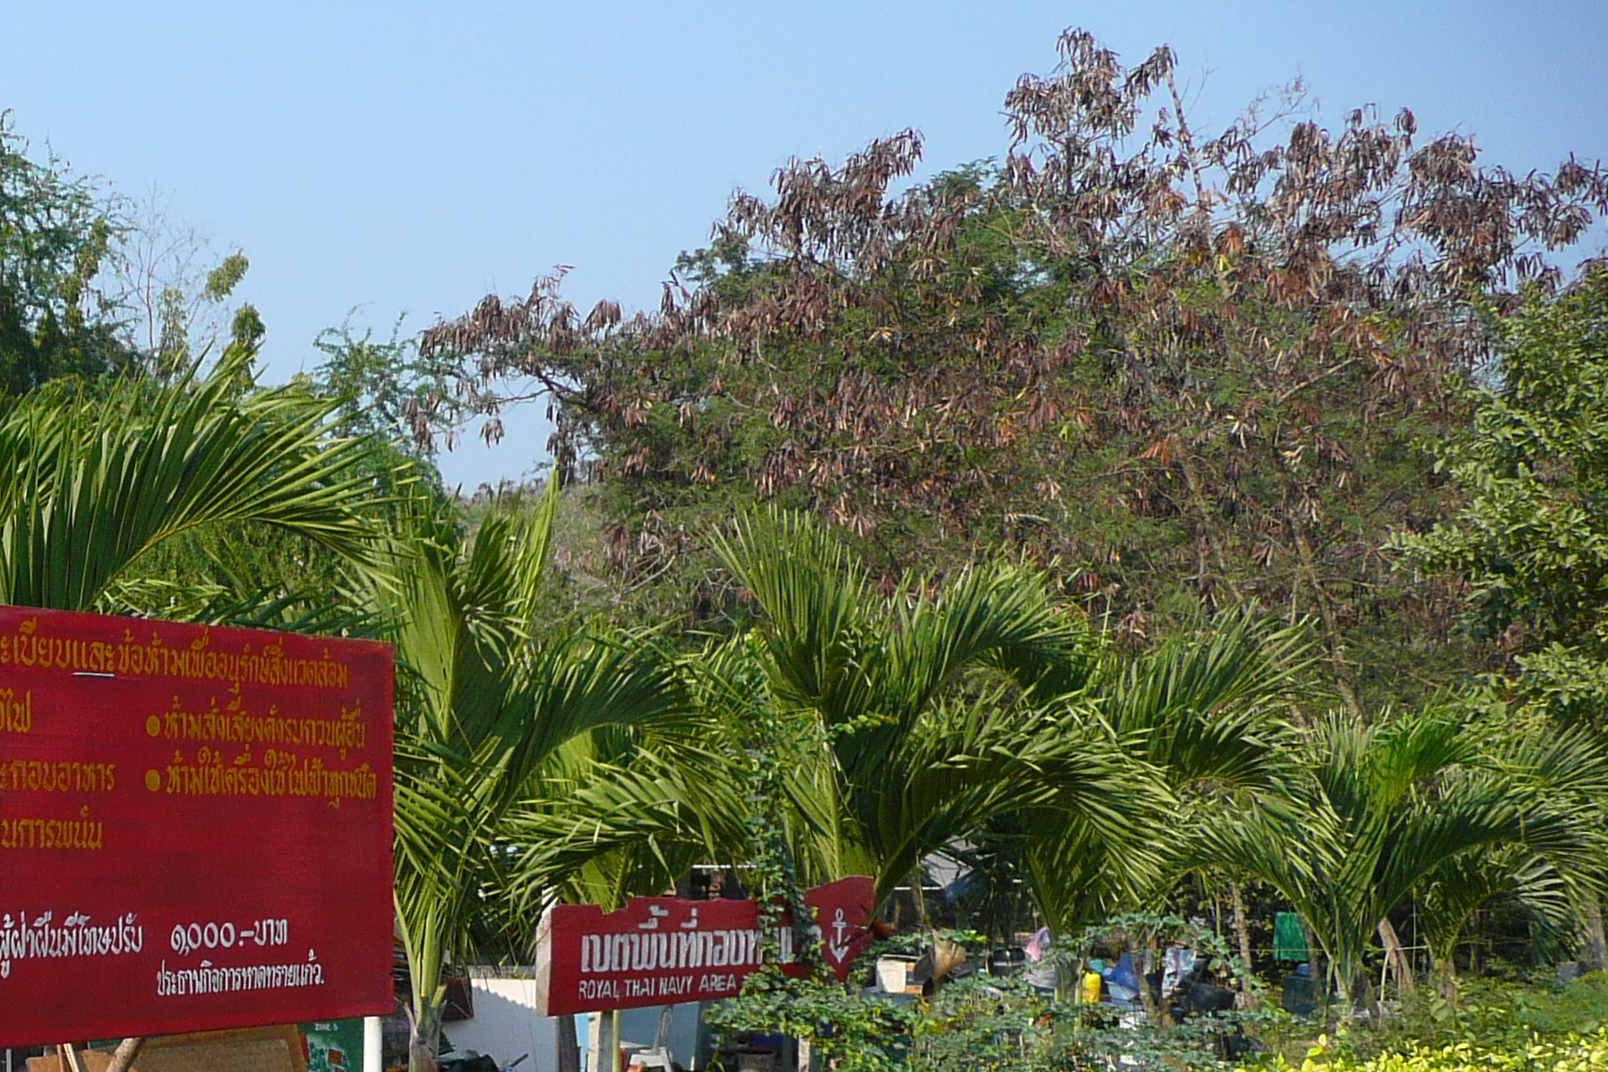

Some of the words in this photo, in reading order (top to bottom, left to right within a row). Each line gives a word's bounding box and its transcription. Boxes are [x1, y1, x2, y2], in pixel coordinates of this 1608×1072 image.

[164, 696, 365, 760] ห้ามส่งเสียงดังรบกวนผู้อื่น
[166, 744, 377, 808] ห้ามใช้เครื่องใช้ไฟฟ้าทุกชนิด
[581, 905, 822, 973] เขตพื้นที่กองทเอ
[579, 979, 619, 1000] ROYAL
[624, 977, 655, 997] THAI
[659, 976, 693, 996] NAVY
[699, 973, 737, 992] AREA
